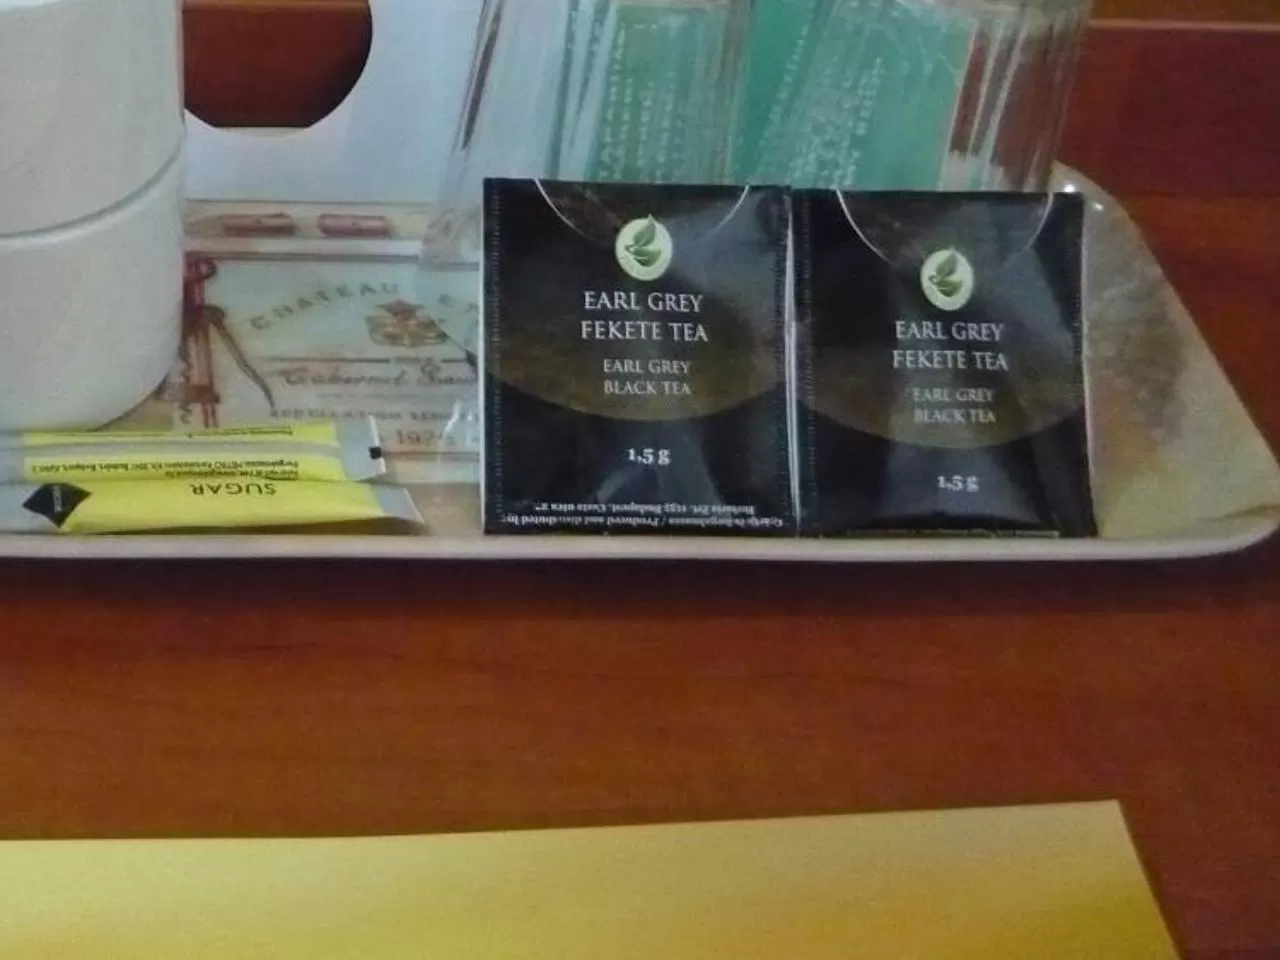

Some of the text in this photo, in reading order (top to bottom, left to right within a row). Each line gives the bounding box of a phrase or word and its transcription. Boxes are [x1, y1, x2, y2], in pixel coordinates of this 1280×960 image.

[584, 290, 703, 313] EARL GREY
[581, 320, 709, 343] FEKETE TEA
[895, 320, 1005, 343] EARL GREY
[603, 358, 692, 376] EARL GREY
[892, 350, 1009, 372] FEKETE TEA
[603, 380, 693, 395] BLACK TEA
[911, 388, 994, 402] EARL GREY
[913, 408, 997, 424] BLACK TEA
[626, 448, 671, 465] 1,5 g
[191, 483, 277, 496] SUGAR
